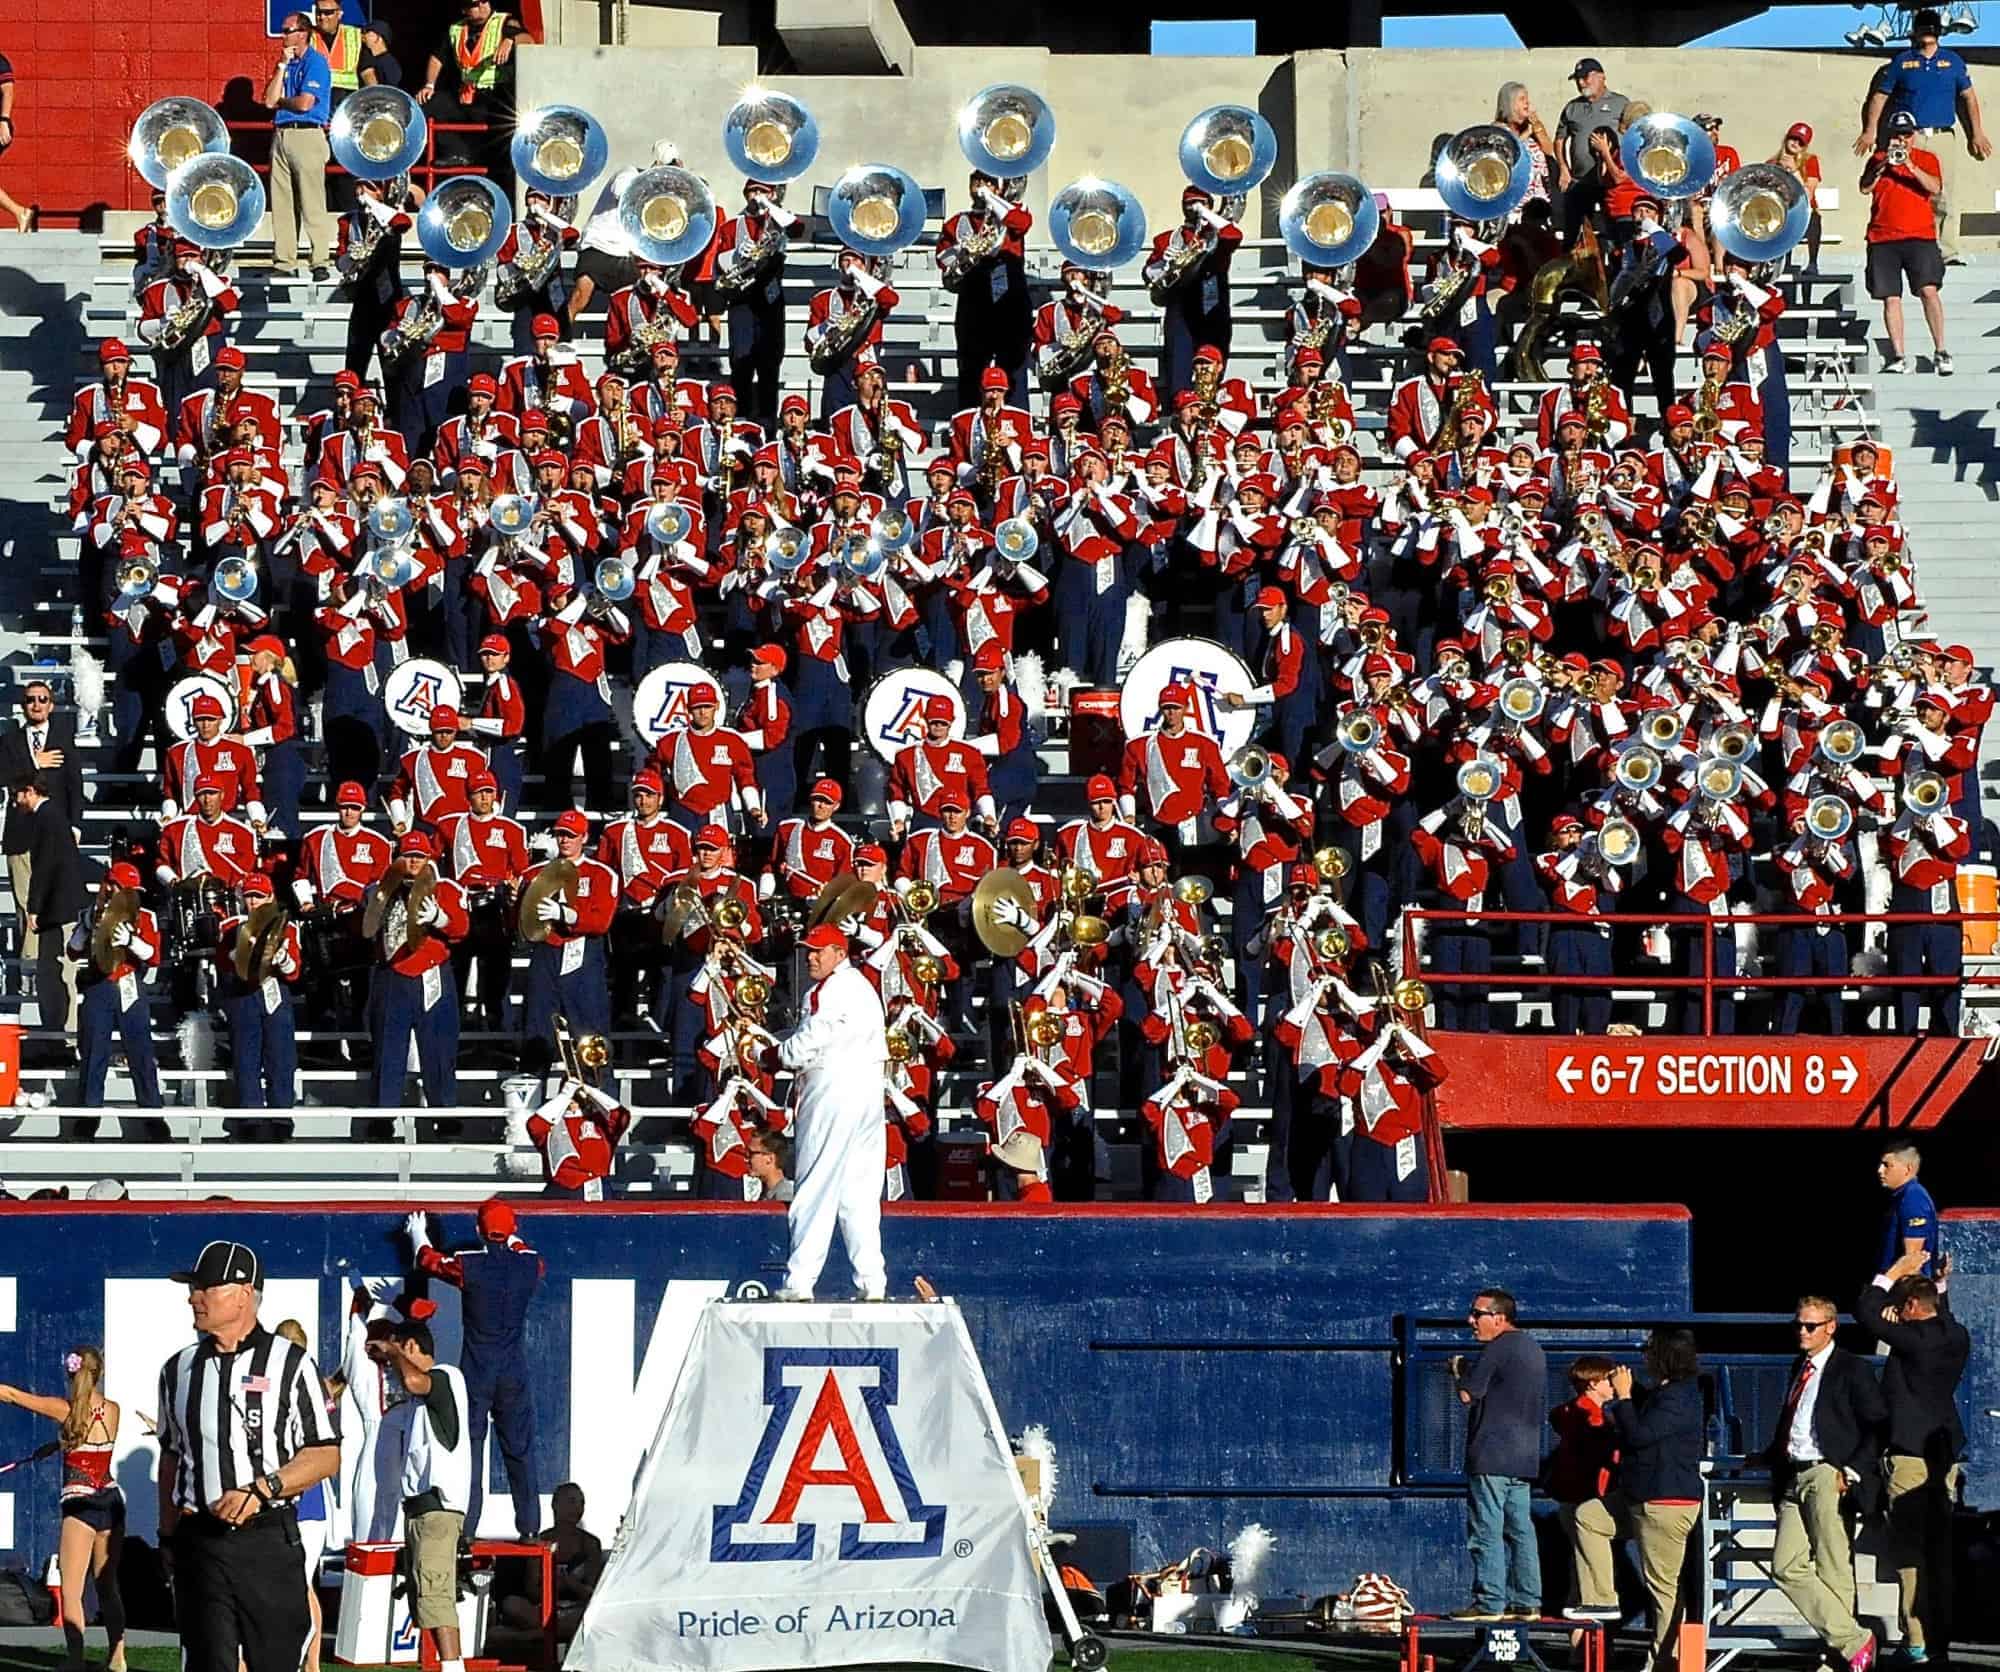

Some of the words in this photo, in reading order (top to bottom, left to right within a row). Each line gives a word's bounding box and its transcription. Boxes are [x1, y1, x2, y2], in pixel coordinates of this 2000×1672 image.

[395, 672, 443, 719] A
[1590, 1055, 1645, 1094] 6-7
[1656, 1055, 1792, 1094] SECTION
[1804, 1055, 1825, 1094] 8
[247, 1408, 262, 1428] S
[709, 1347, 947, 1563] A
[677, 1609, 760, 1637] Pride
[775, 1606, 810, 1634] of
[825, 1604, 957, 1633] Arizona
[1488, 1641, 1520, 1653] BAND
[1491, 1629, 1517, 1641] THE
[1495, 1652, 1516, 1661] KID
